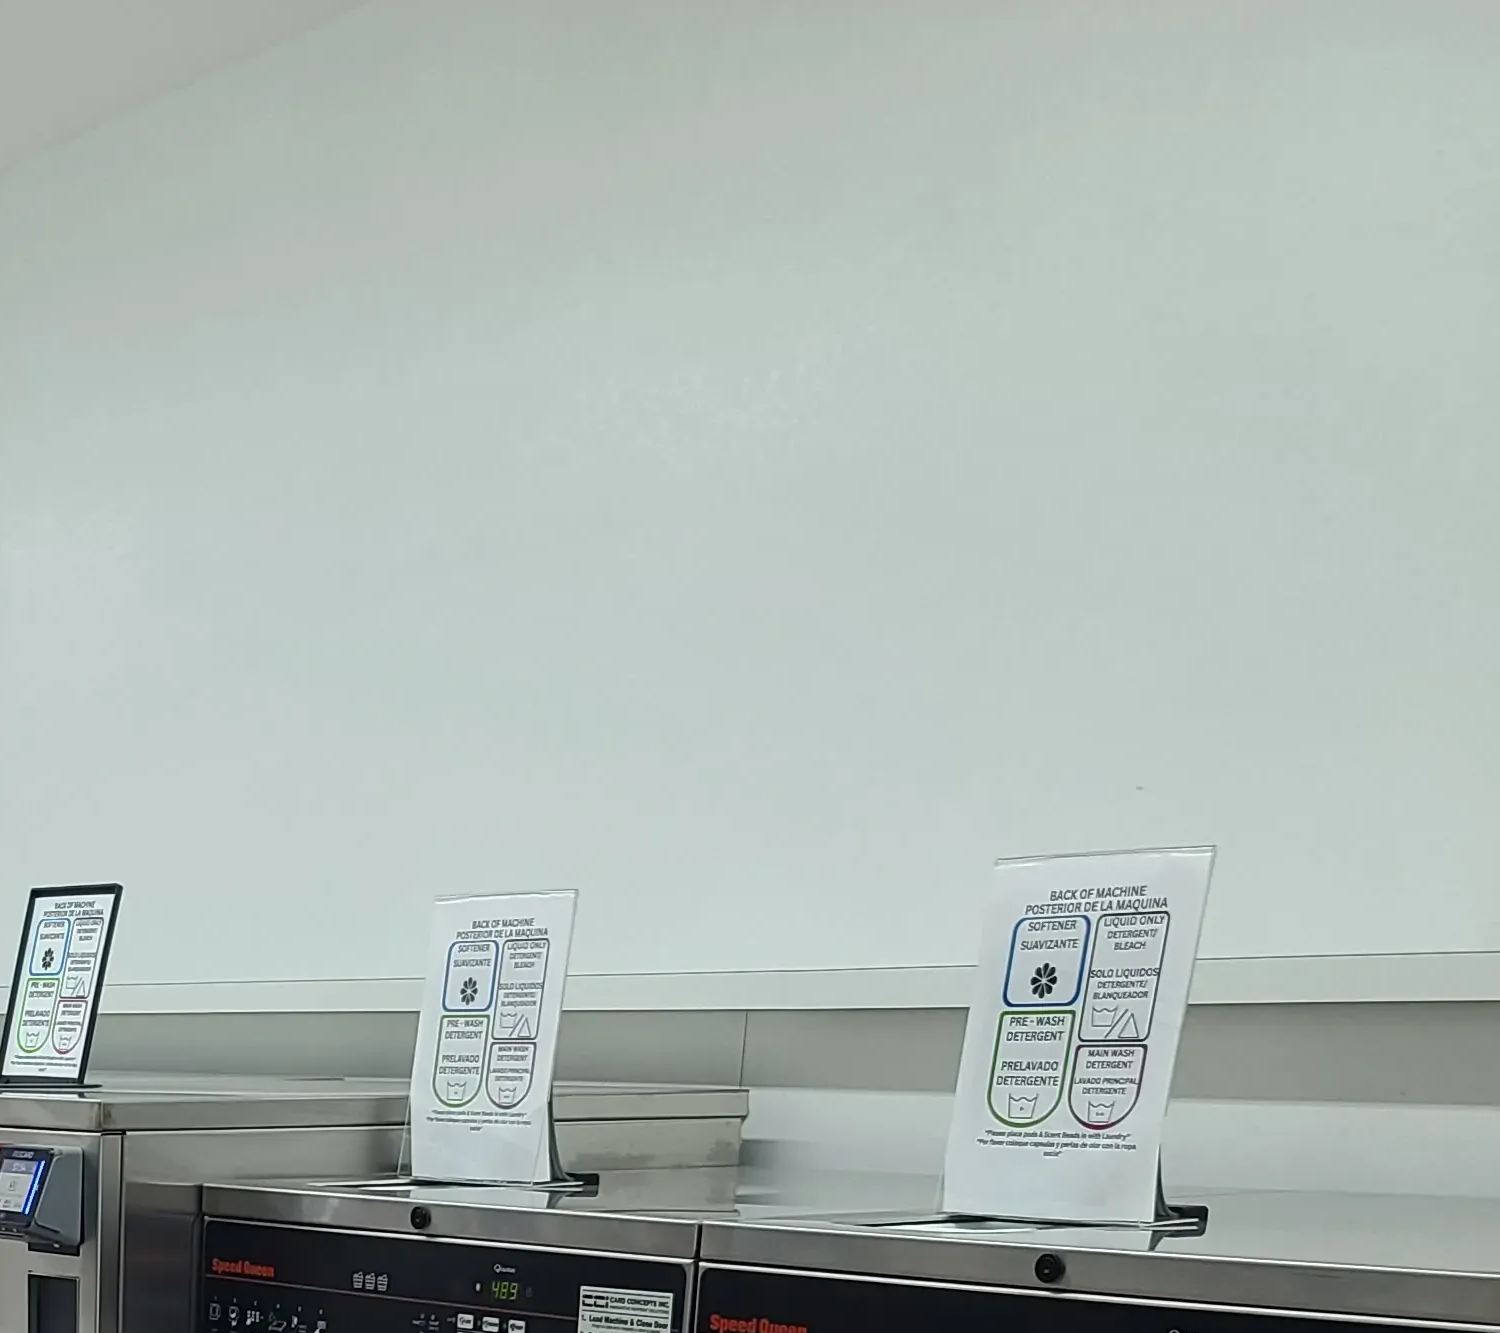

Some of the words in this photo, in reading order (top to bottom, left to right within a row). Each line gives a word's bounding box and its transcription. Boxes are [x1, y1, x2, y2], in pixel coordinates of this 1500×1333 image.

[1049, 889, 1078, 901] BACK
[1079, 888, 1095, 900] OF
[1095, 884, 1148, 899] MACHINE
[1024, 901, 1082, 915] POSTERIOR
[1083, 901, 1100, 912] DE
[1100, 900, 1114, 912] LA
[1116, 897, 1169, 911] MAQUINA
[472, 920, 490, 929] BACK
[491, 919, 501, 928] OF
[502, 917, 535, 927] MACHINE
[1027, 920, 1077, 932] SOFTENER
[1103, 916, 1137, 928] LIQUID
[1139, 915, 1166, 926] ONLY
[456, 930, 493, 940] POSTERIOR
[494, 929, 503, 938] DE
[504, 929, 513, 937] LA
[515, 928, 548, 938] MAQUINA
[457, 944, 491, 953] SOFTENER
[1020, 938, 1079, 951] SUAVIZANTE
[1113, 941, 1146, 951] BLEACH
[453, 958, 492, 968] SUAVIZANTE
[1089, 969, 1114, 979] SOLO
[1115, 967, 1159, 979] LIQUIDOS
[1092, 991, 1149, 1000] BLANQUEADOR
[444, 1030, 483, 1040] DETERGENT
[1006, 1031, 1066, 1042] DETERGENT
[441, 1054, 480, 1063] PRELAVADO
[1088, 1049, 1109, 1057] MAIN
[1110, 1049, 1135, 1057] WASH
[438, 1066, 480, 1075] DETERGENTE
[1001, 1060, 1059, 1072] PRELAVADO
[1085, 1060, 1134, 1069] DETERGENT
[996, 1075, 1060, 1087] DETERGENTE
[1082, 1087, 1127, 1095] DETERGENTE
[211, 1258, 242, 1274] Speed
[243, 1260, 275, 1278] Queen
[491, 1280, 518, 1300] 489
[709, 1313, 757, 1333] Speed
